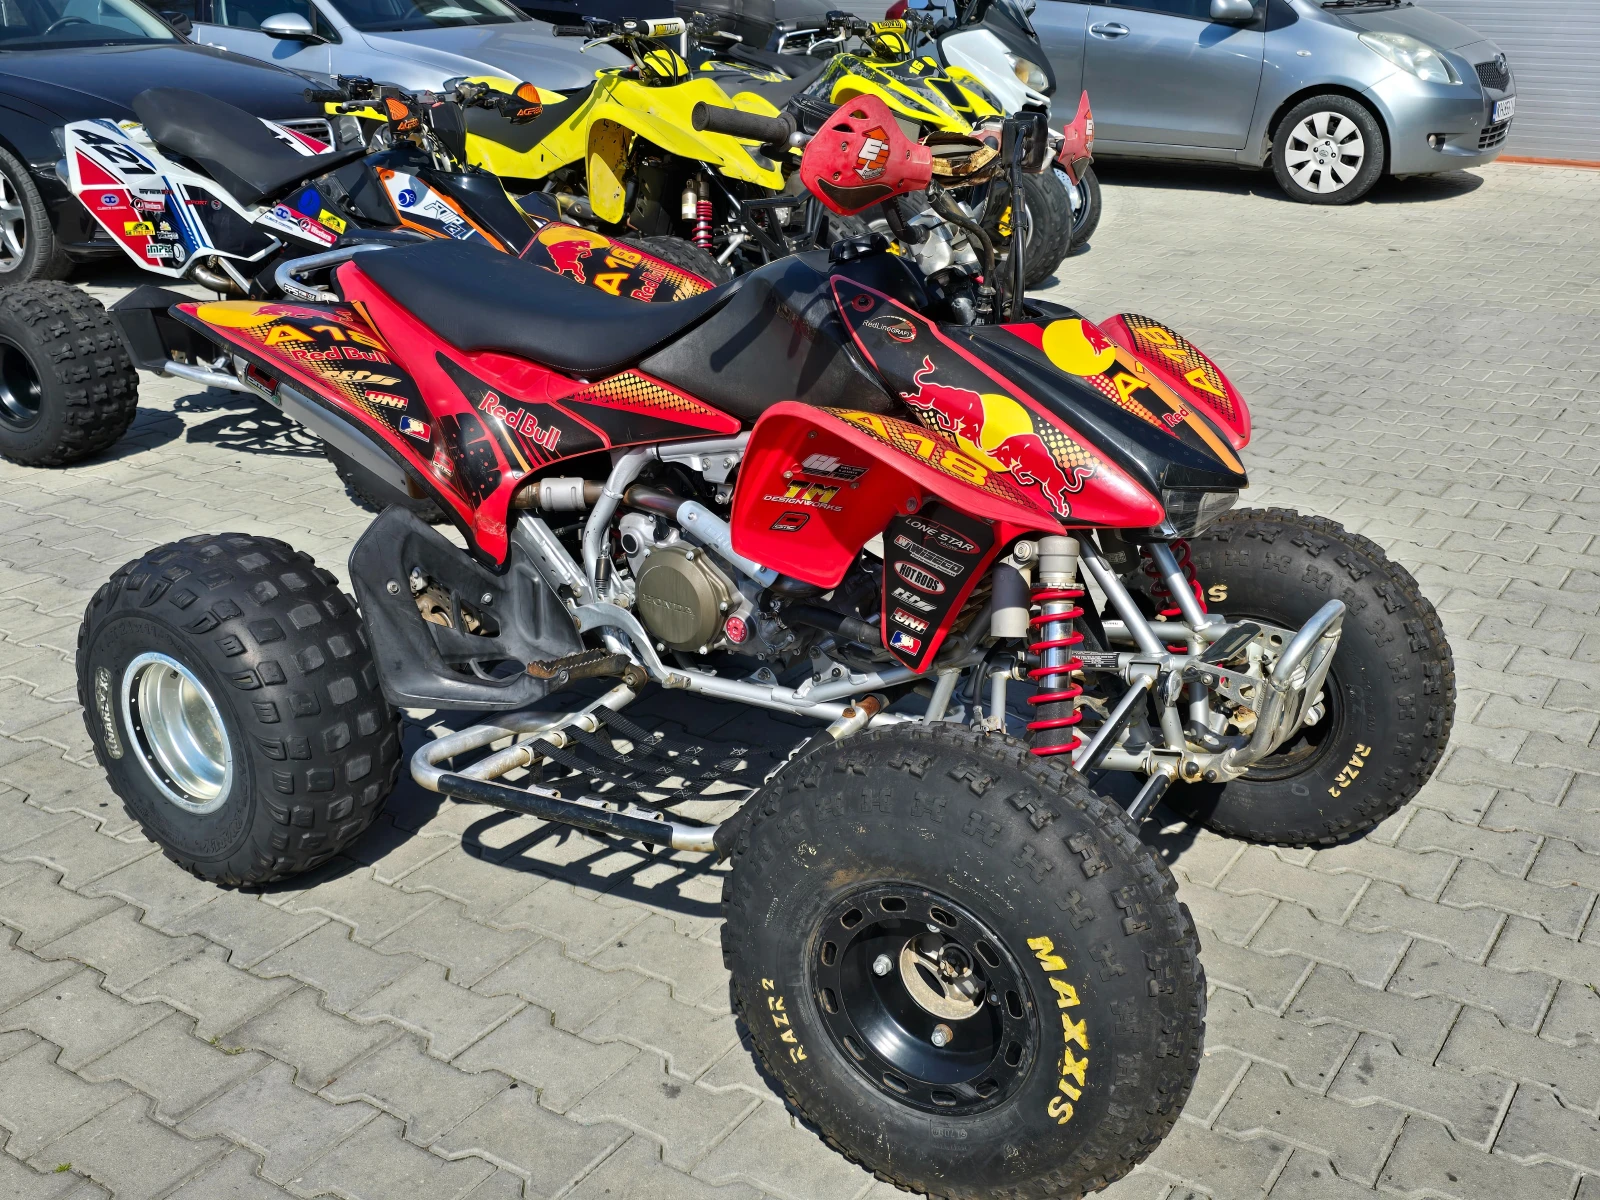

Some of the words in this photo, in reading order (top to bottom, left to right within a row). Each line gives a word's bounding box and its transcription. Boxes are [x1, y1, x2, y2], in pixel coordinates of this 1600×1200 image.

[397, 118, 419, 130] ACERB
[517, 107, 543, 116] ACERB
[72, 129, 157, 174] 421
[593, 248, 644, 297] A18
[263, 324, 388, 352] A18
[291, 346, 343, 362] Red
[342, 346, 392, 365] Bull
[1134, 327, 1228, 399] A18
[479, 391, 526, 433] Red
[518, 413, 562, 452] Bull
[1161, 407, 1190, 428] Red
[835, 410, 989, 486] A18
[763, 494, 843, 512] DESIGNWORKS
[785, 480, 841, 504] TM
[905, 517, 939, 536] LONE
[937, 532, 975, 551] STAR
[899, 563, 916, 582] HOT
[914, 570, 940, 592] RODS
[643, 593, 695, 619] HONDA
[1335, 742, 1372, 789] RAZR
[1327, 785, 1341, 799] 2
[762, 977, 775, 991] 2
[770, 996, 808, 1064] RAZR
[1026, 935, 1091, 1126] MAXXIS
